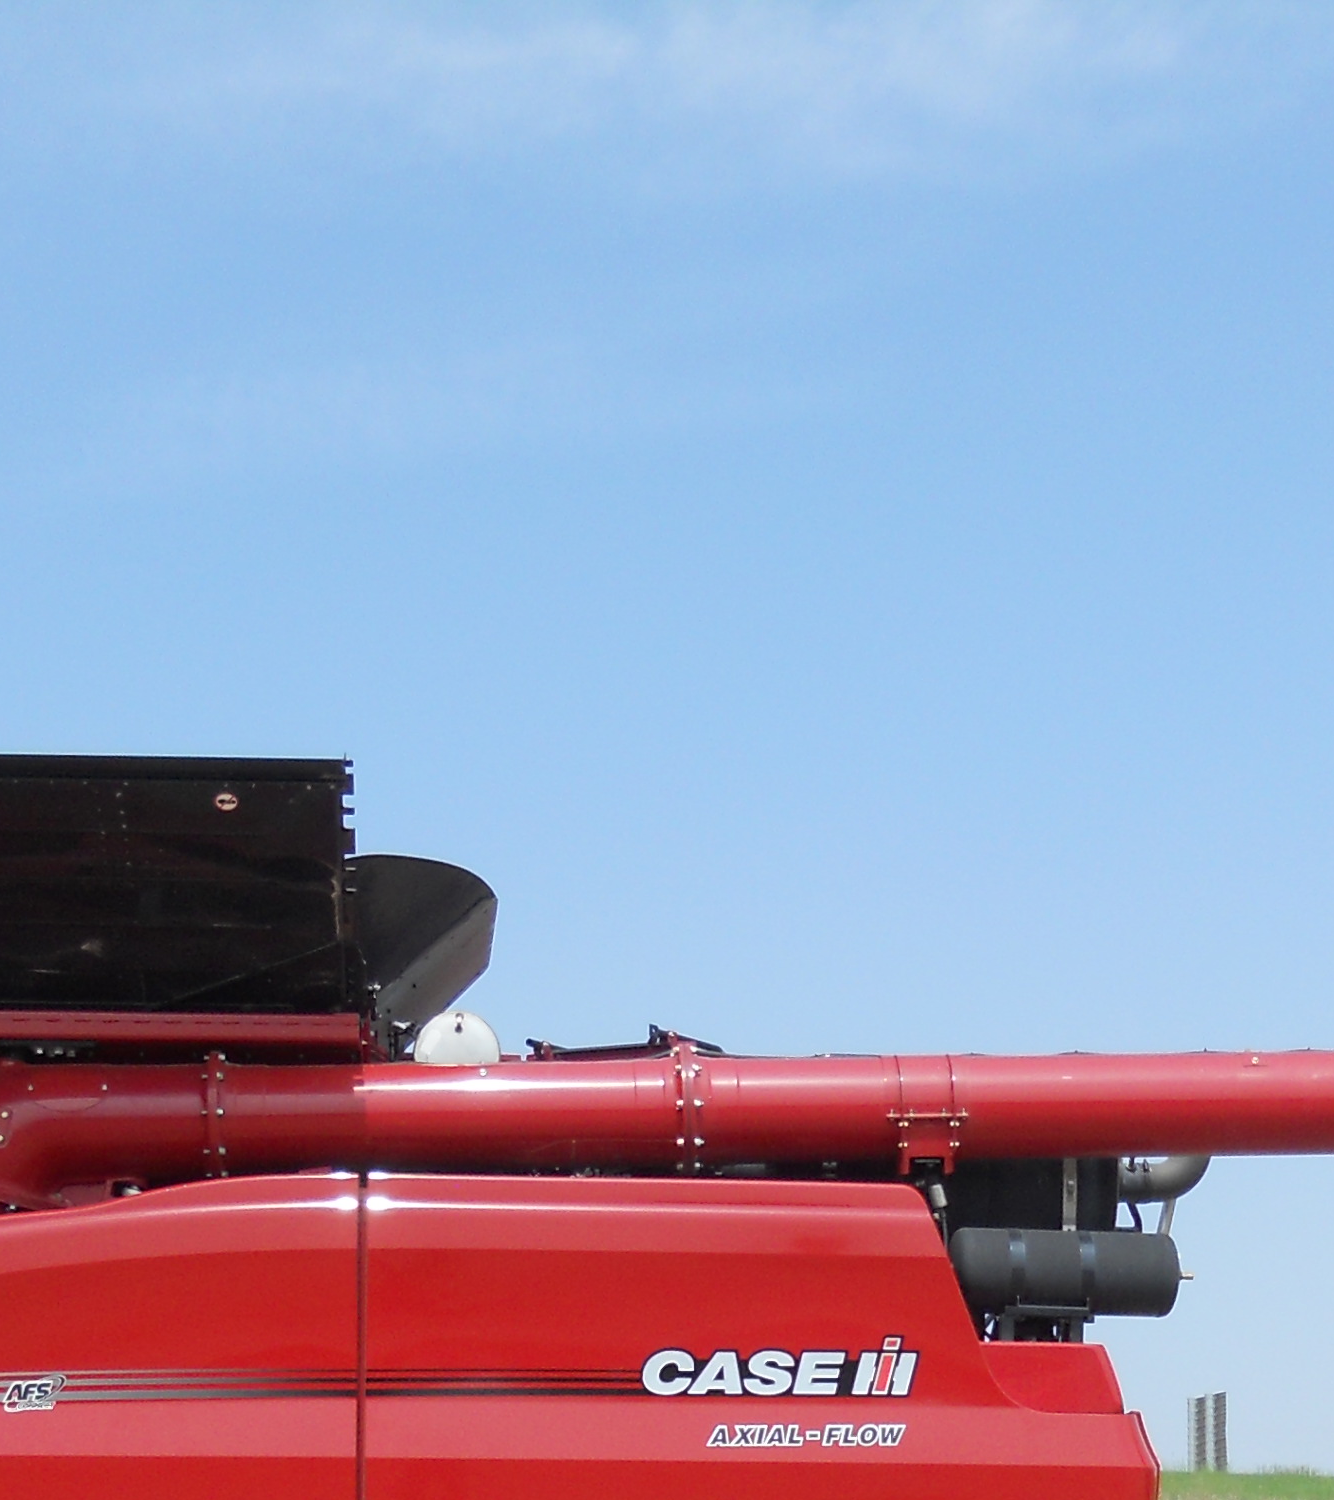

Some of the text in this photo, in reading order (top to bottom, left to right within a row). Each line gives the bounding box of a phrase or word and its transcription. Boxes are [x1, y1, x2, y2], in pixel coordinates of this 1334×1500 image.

[641, 1349, 847, 1396] CASE
[4, 1380, 53, 1402] AFS
[706, 1424, 907, 1447] AXIAL-FLOW
